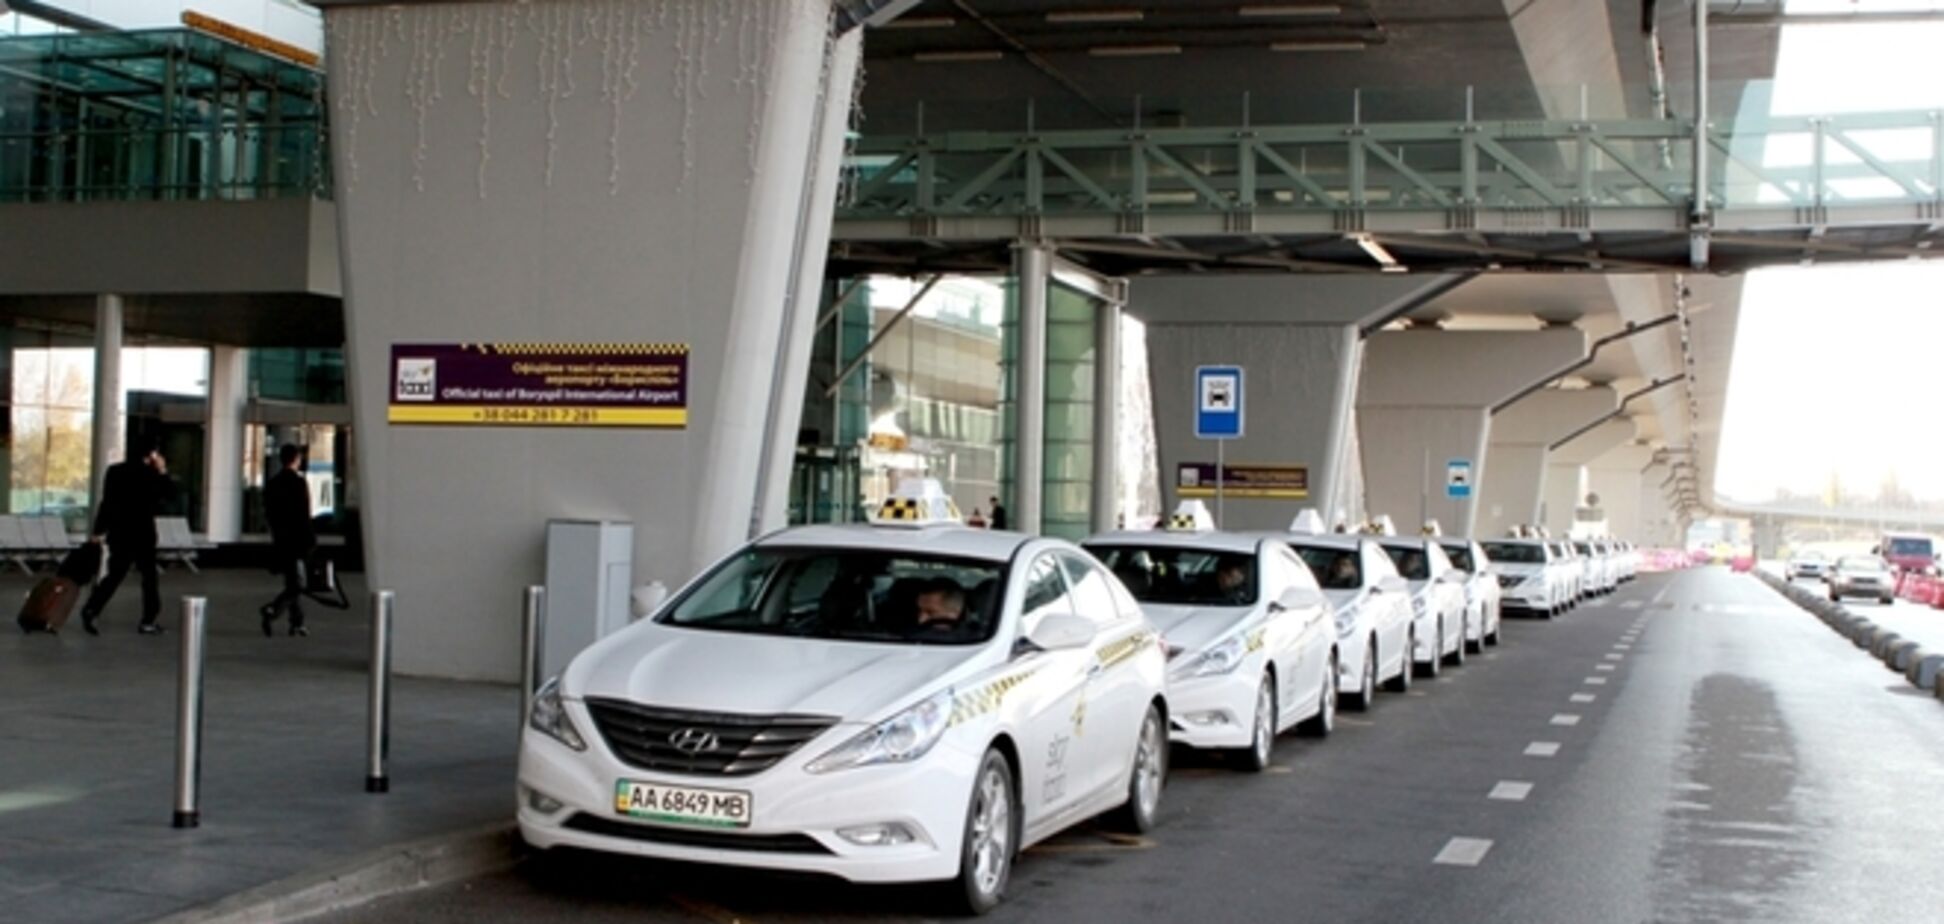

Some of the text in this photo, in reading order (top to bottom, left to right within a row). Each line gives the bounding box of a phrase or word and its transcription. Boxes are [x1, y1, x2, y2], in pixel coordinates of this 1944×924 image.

[441, 387, 481, 399] Official
[638, 390, 679, 403] Airport
[631, 786, 745, 817] AA 6849 MB
